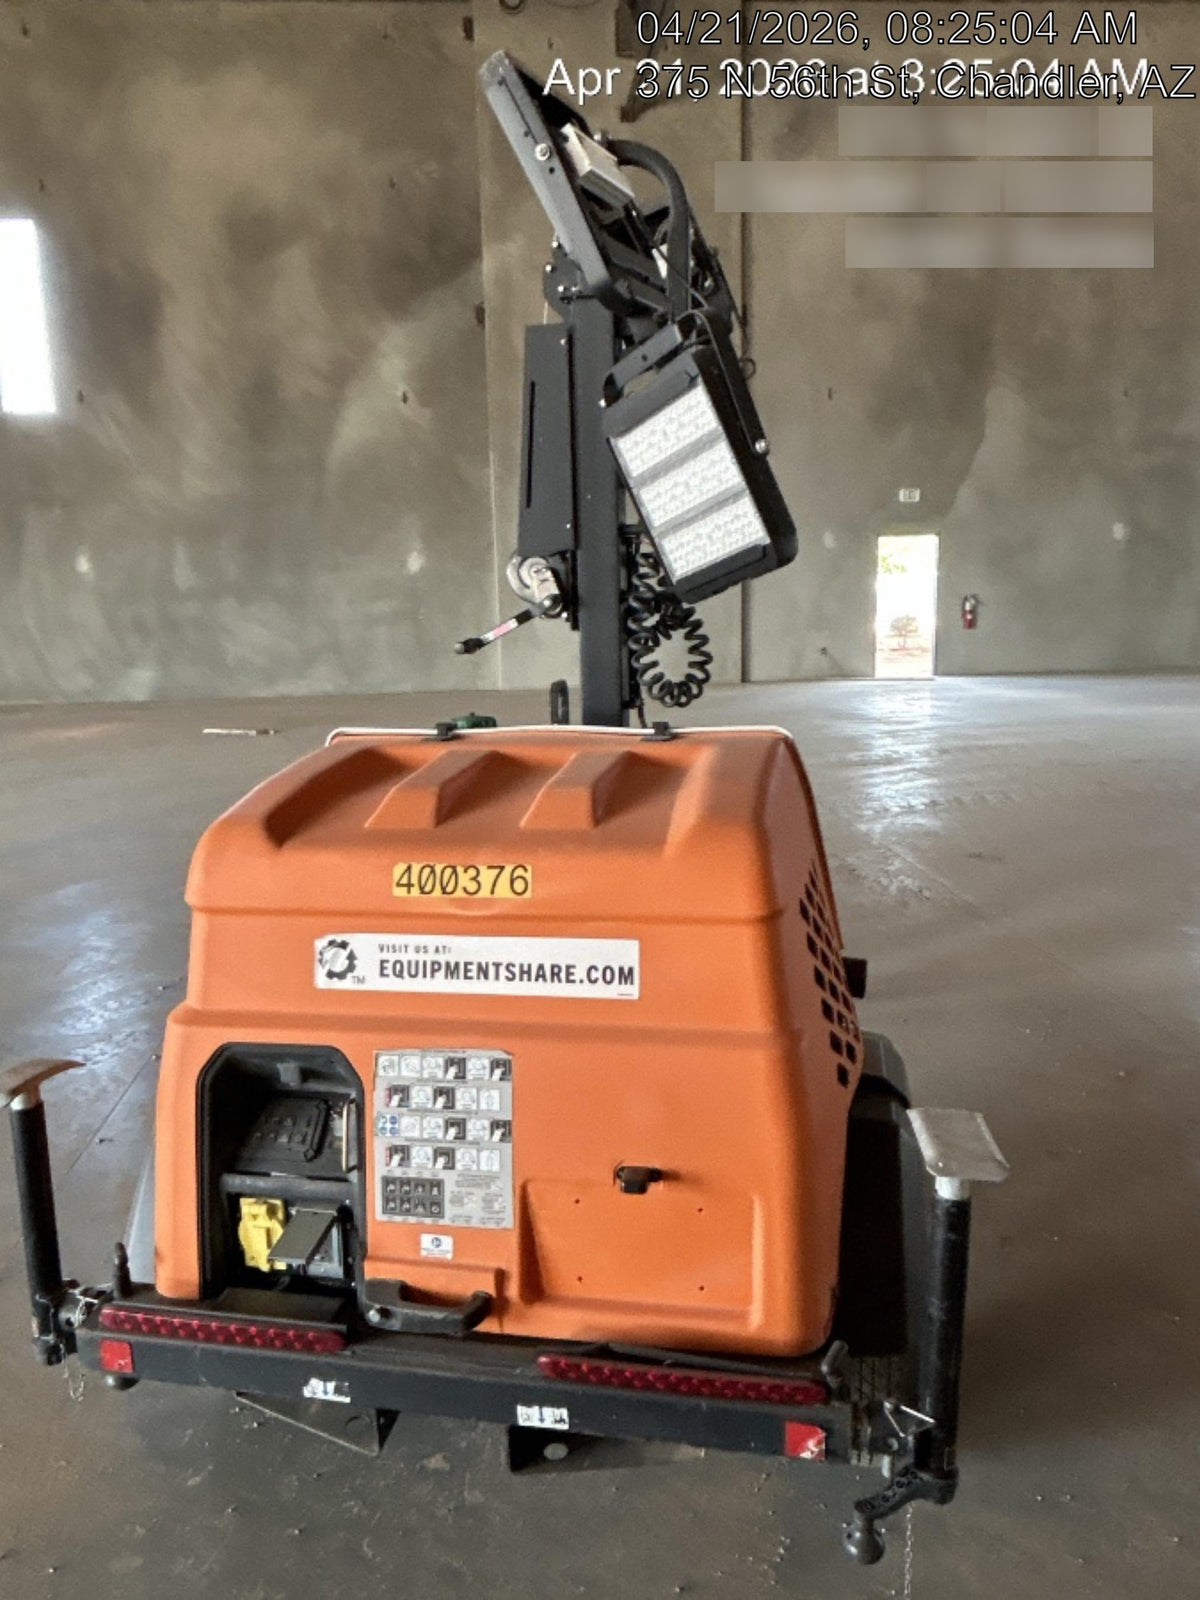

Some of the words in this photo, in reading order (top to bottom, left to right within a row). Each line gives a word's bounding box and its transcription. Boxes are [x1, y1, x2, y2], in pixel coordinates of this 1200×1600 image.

[395, 863, 530, 896] 400376
[378, 943, 410, 954] VISIT
[414, 944, 430, 955] US
[351, 975, 366, 985] TM
[378, 959, 635, 986] EQUIPMENTSHARE.COM
